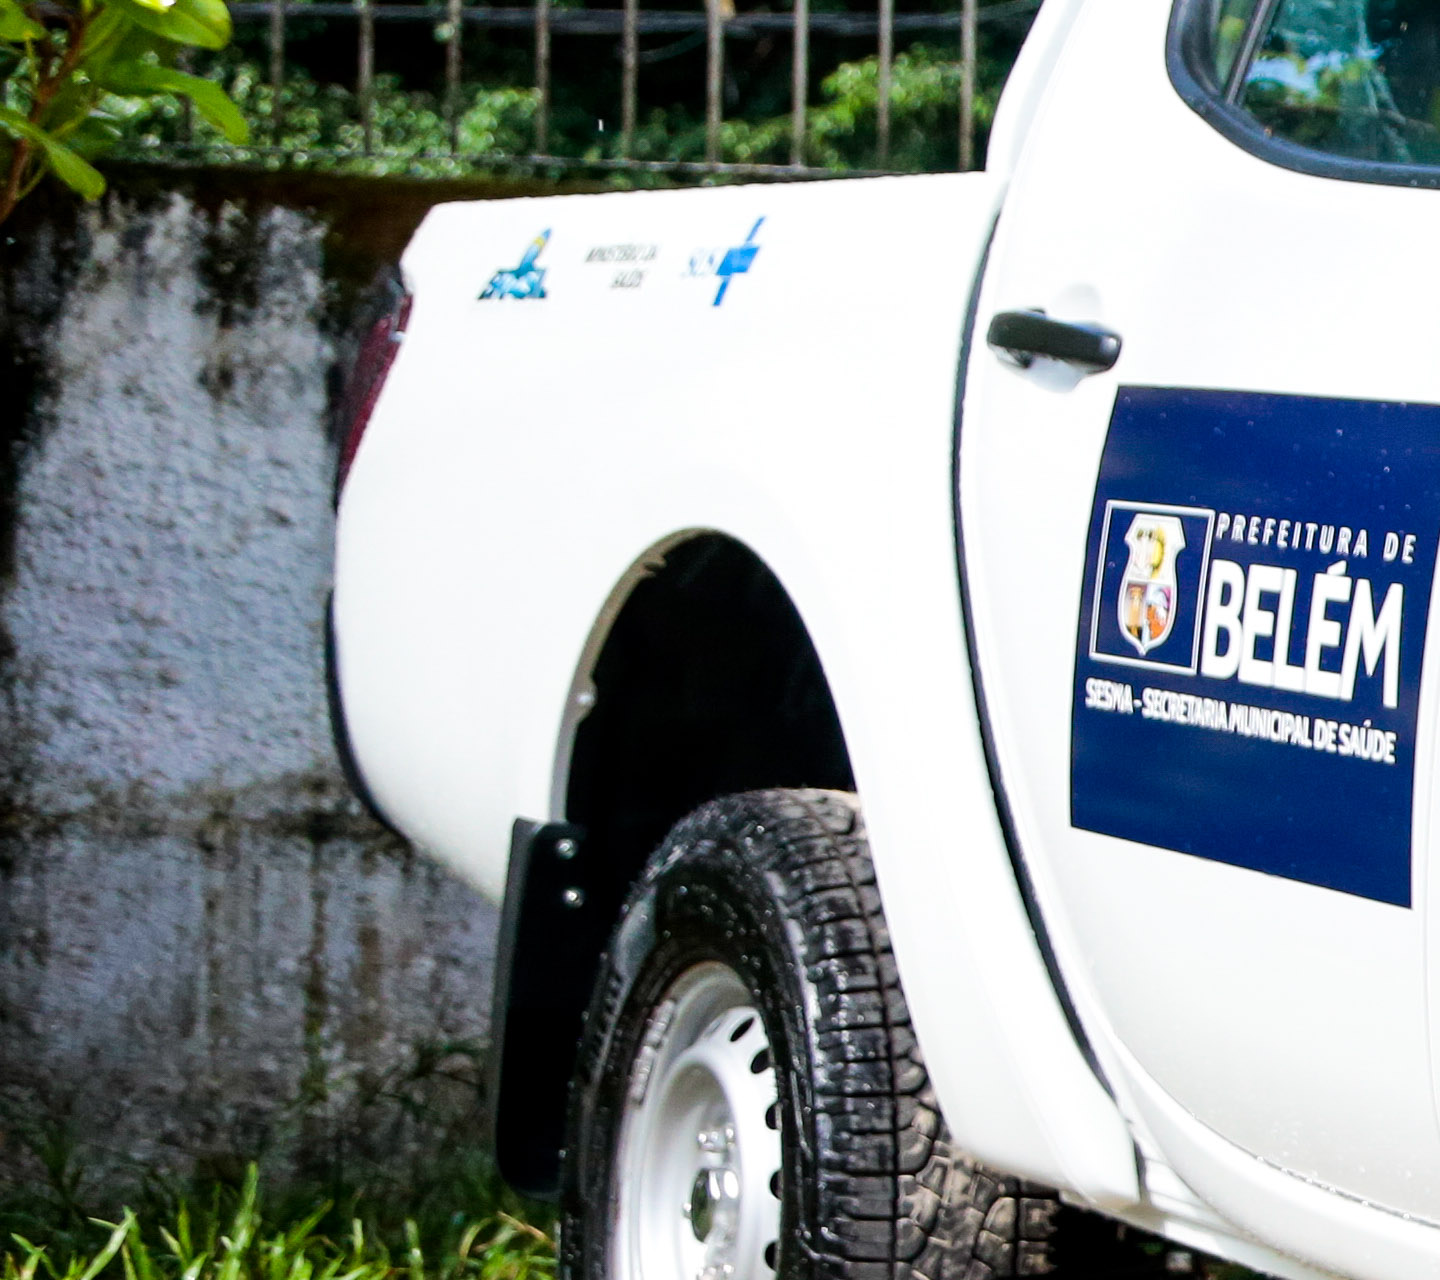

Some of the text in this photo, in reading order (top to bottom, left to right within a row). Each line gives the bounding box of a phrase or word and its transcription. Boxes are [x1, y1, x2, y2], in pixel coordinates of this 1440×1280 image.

[1215, 512, 1417, 565] PREFEITURA DE
[1200, 560, 1404, 710] BELÉM
[1141, 687, 1228, 730] SECRETARIA
[1228, 703, 1313, 748] MUNICIPAL
[1313, 718, 1339, 753] DE
[1338, 719, 1397, 765] SAÚDE
